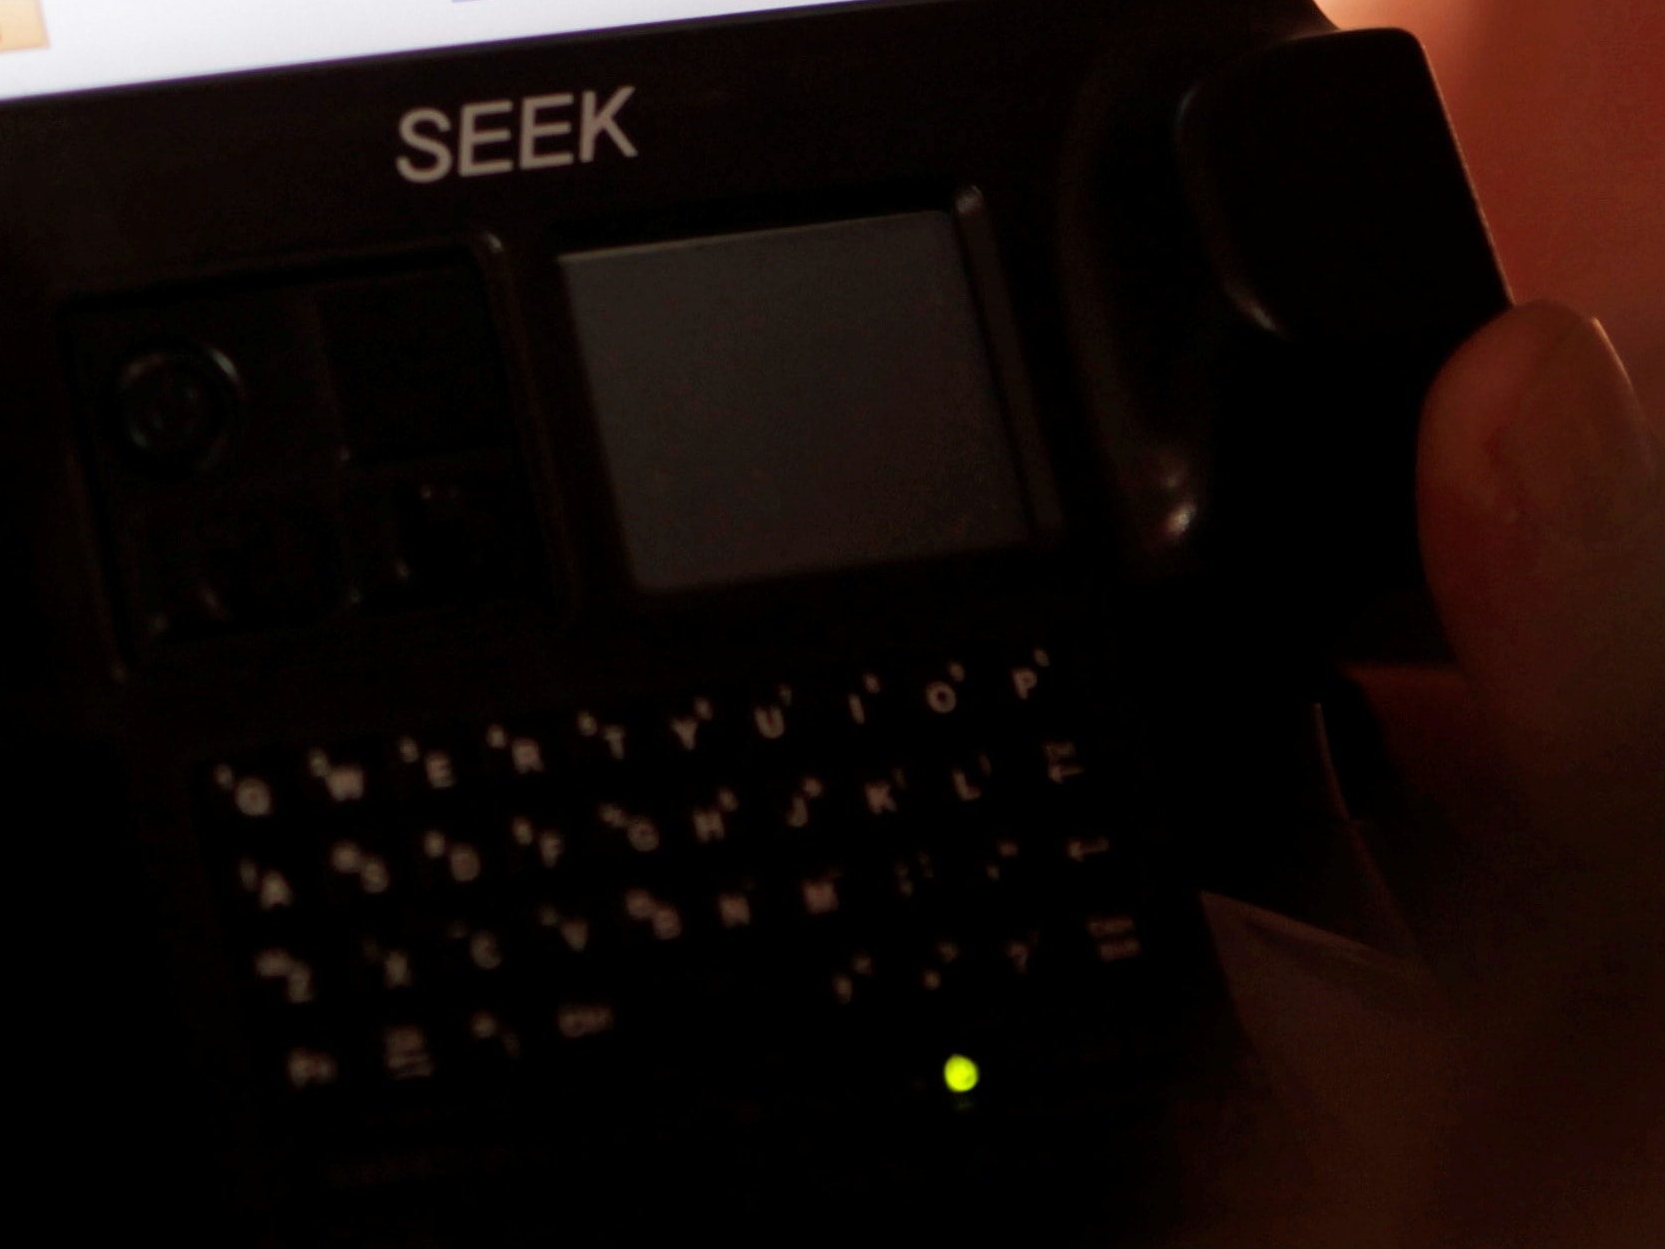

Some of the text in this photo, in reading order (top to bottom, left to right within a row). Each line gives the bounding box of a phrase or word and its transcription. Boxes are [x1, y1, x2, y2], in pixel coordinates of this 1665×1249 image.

[395, 84, 639, 184] SEEK
[754, 706, 785, 739] U
[1011, 667, 1038, 699] P
